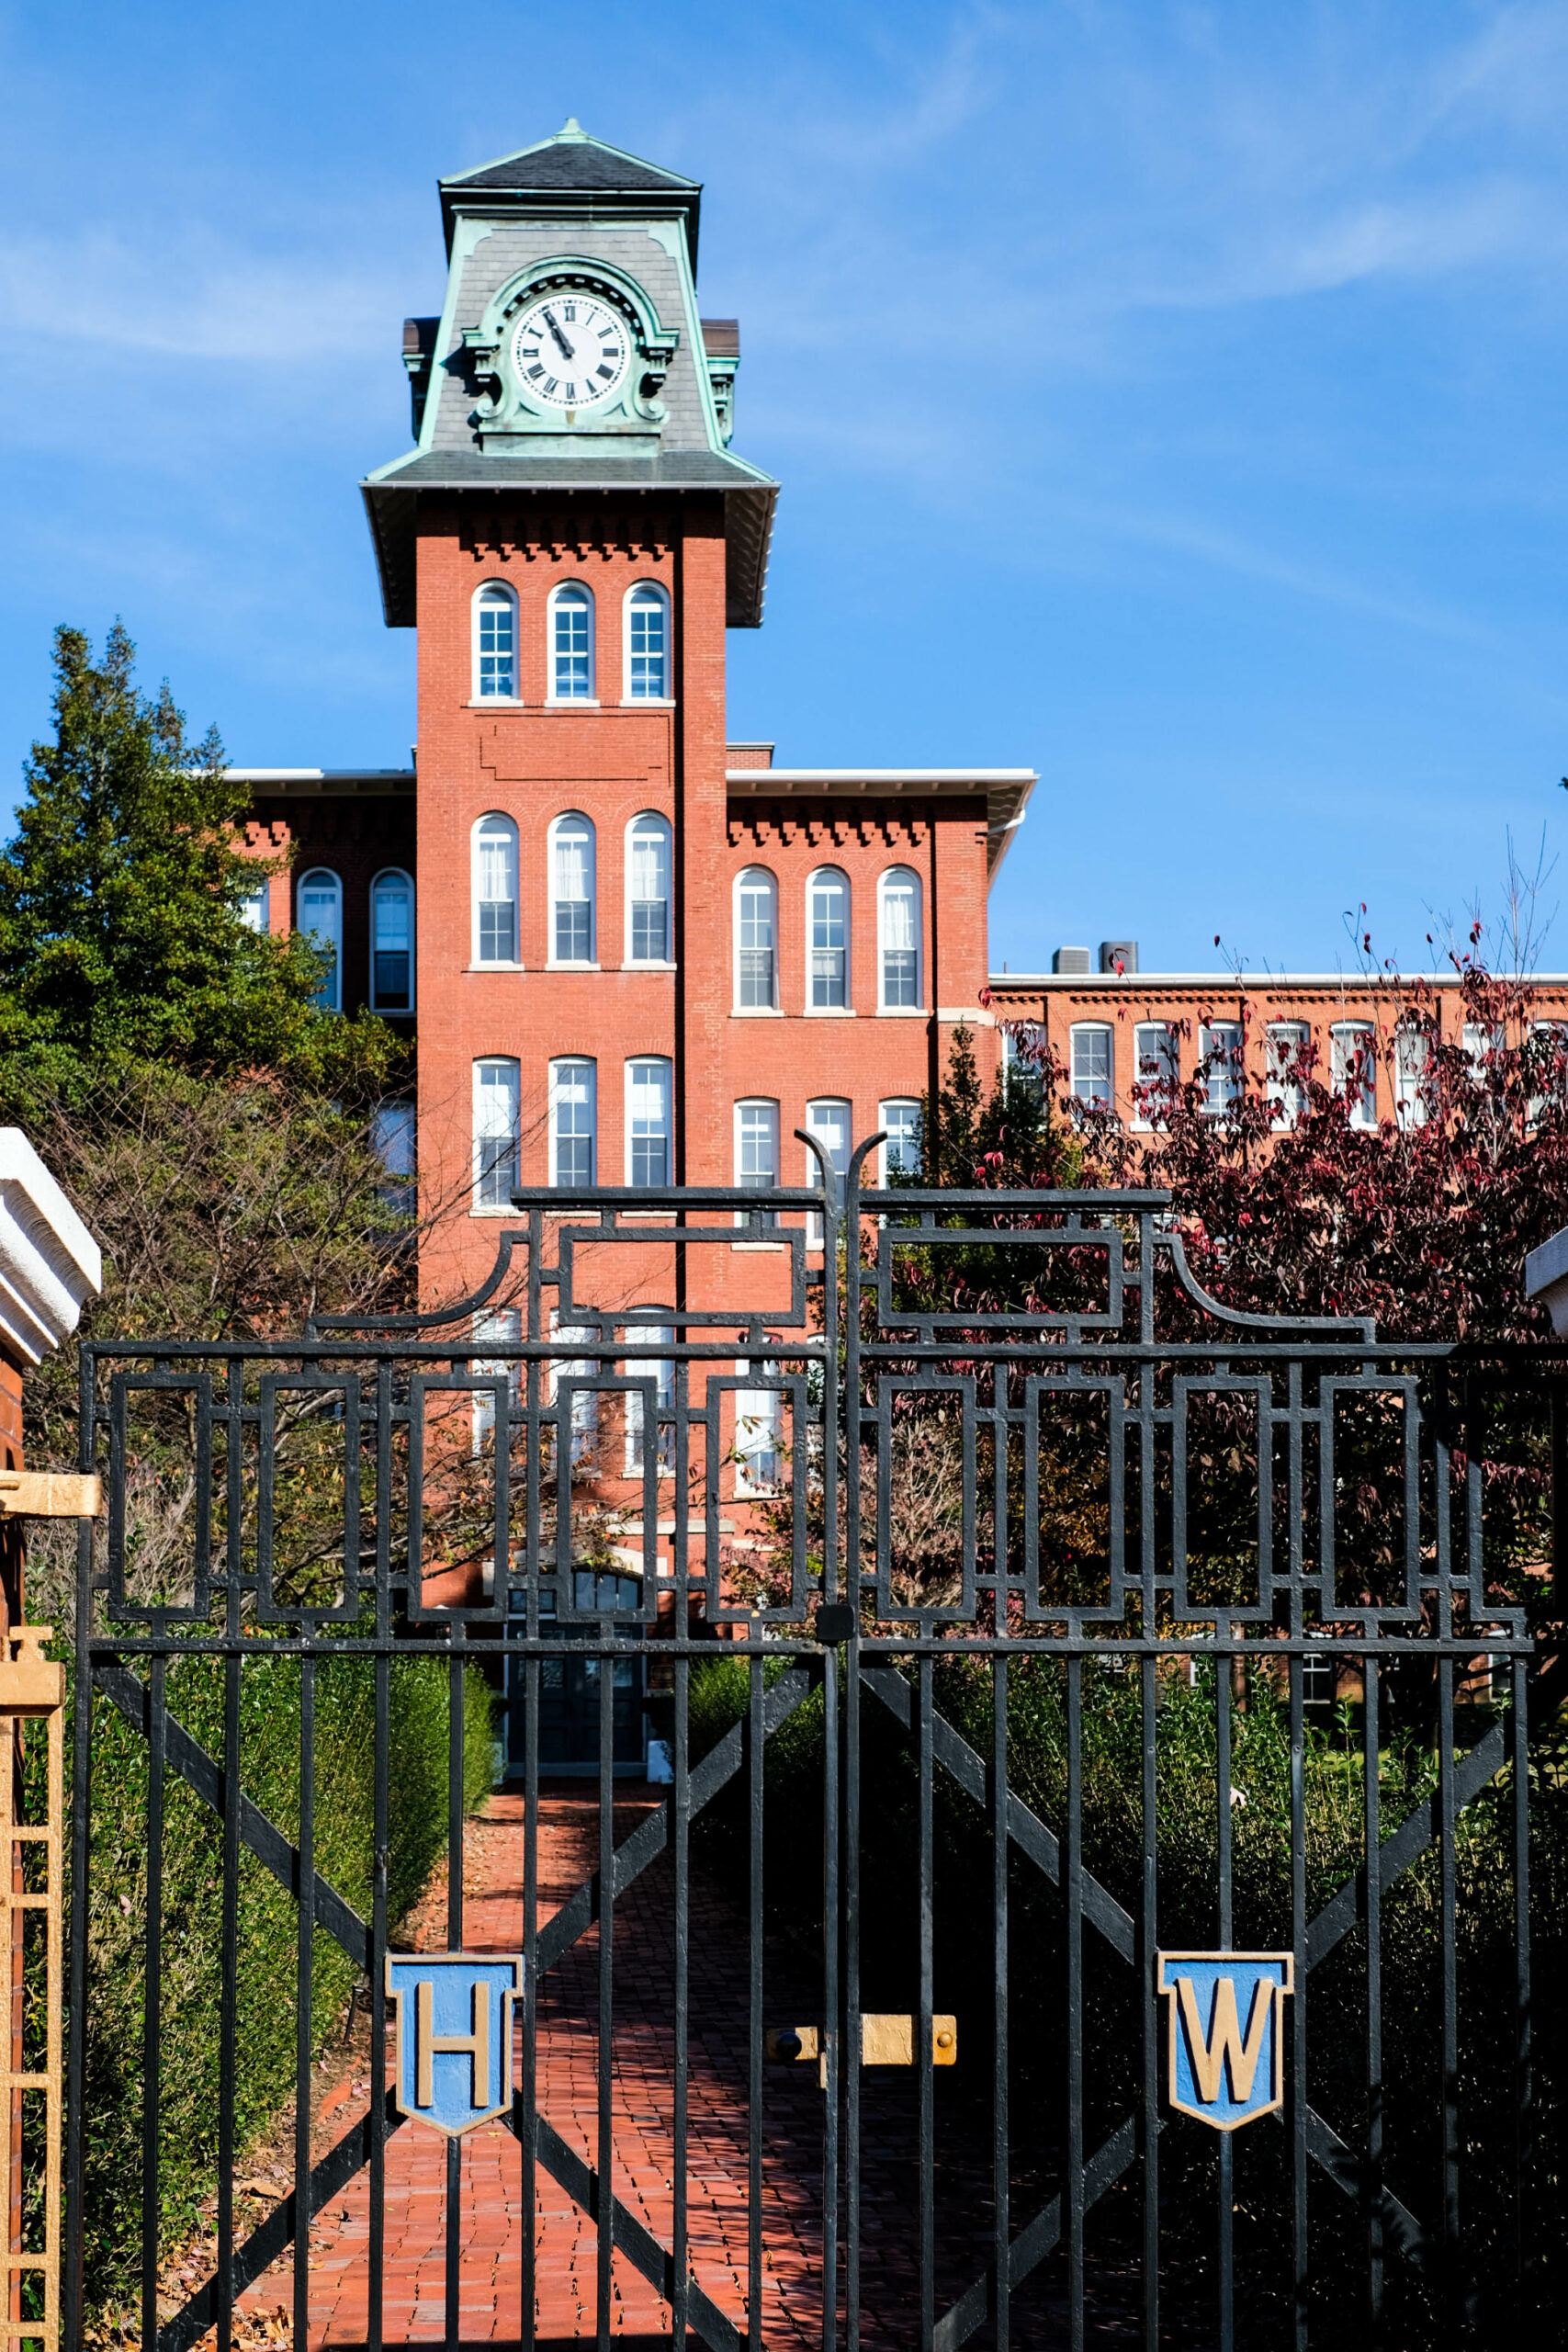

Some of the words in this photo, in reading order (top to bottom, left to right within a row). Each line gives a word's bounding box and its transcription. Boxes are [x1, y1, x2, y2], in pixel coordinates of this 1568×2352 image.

[565, 306, 575, 322] XII
[586, 311, 595, 325] I
[597, 327, 614, 339] II
[566, 382, 576, 399] VI
[586, 379, 597, 394] V
[417, 1981, 490, 2108] H
[1176, 1977, 1274, 2102] W
